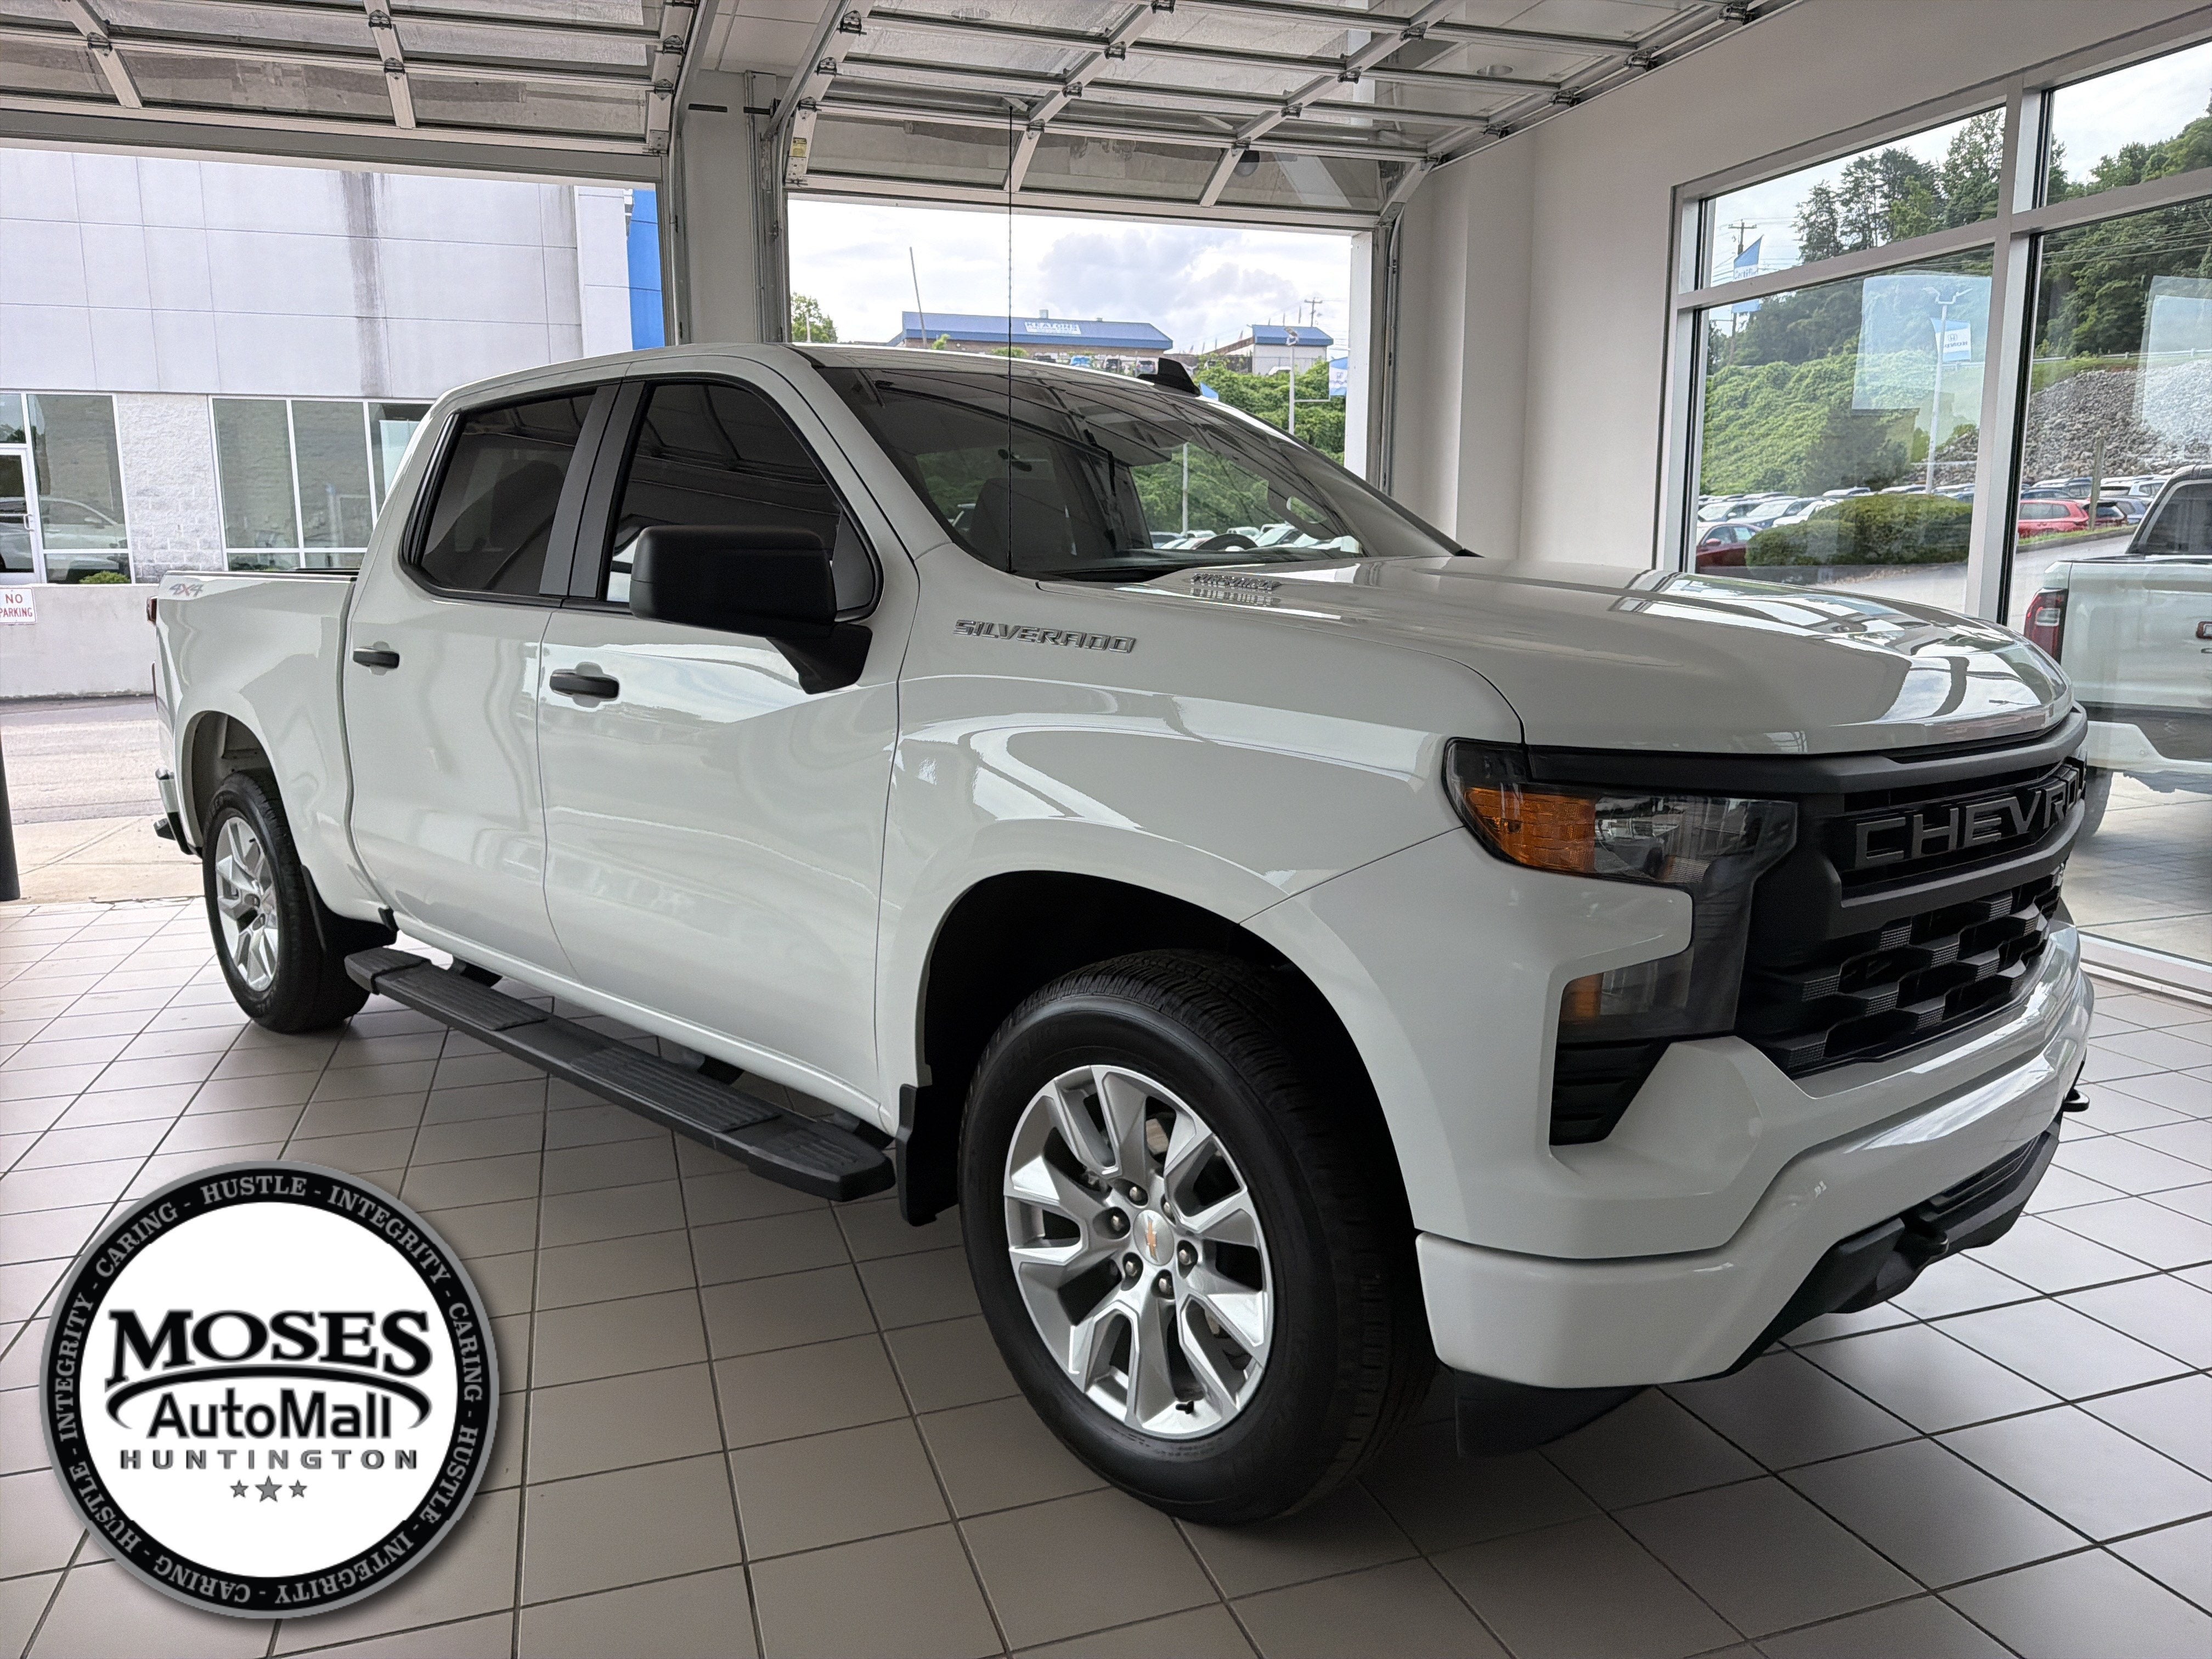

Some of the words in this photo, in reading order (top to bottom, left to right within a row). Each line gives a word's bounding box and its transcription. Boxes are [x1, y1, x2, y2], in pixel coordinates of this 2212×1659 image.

[5, 594, 23, 604] NO
[0, 607, 33, 618] PARKING
[953, 619, 1136, 654] SILVERADO
[1855, 766, 2081, 870] CHEVRO
